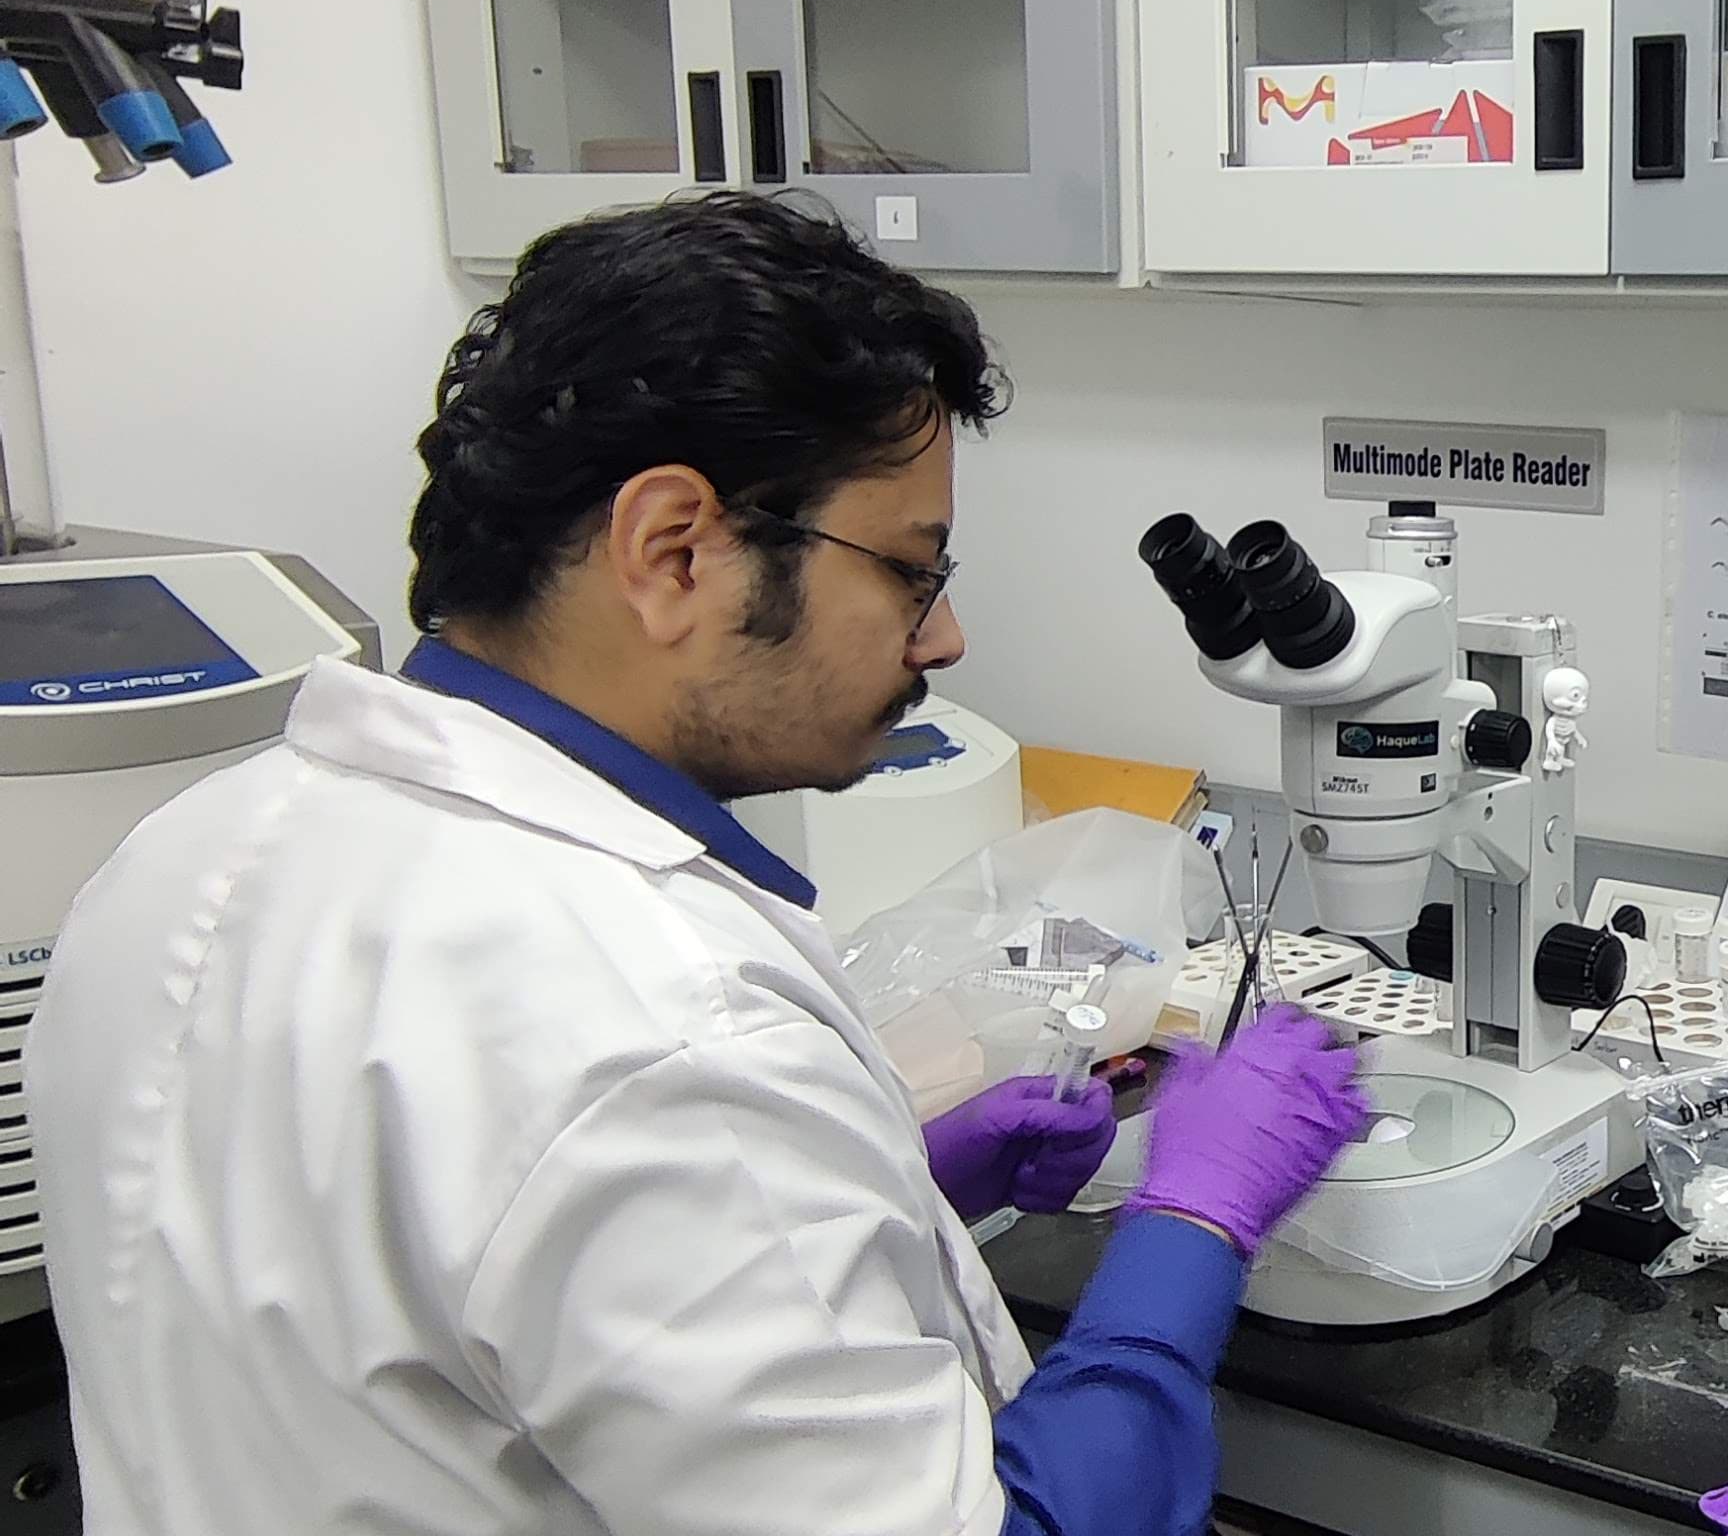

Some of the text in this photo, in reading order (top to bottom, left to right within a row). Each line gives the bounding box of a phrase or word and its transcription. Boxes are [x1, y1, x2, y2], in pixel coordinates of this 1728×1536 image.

[1332, 442, 1592, 488] Multimode Plate Reader
[78, 670, 207, 694] CHRIST
[1376, 733, 1437, 749] HaqueLab
[1321, 782, 1370, 794] SMZ745T
